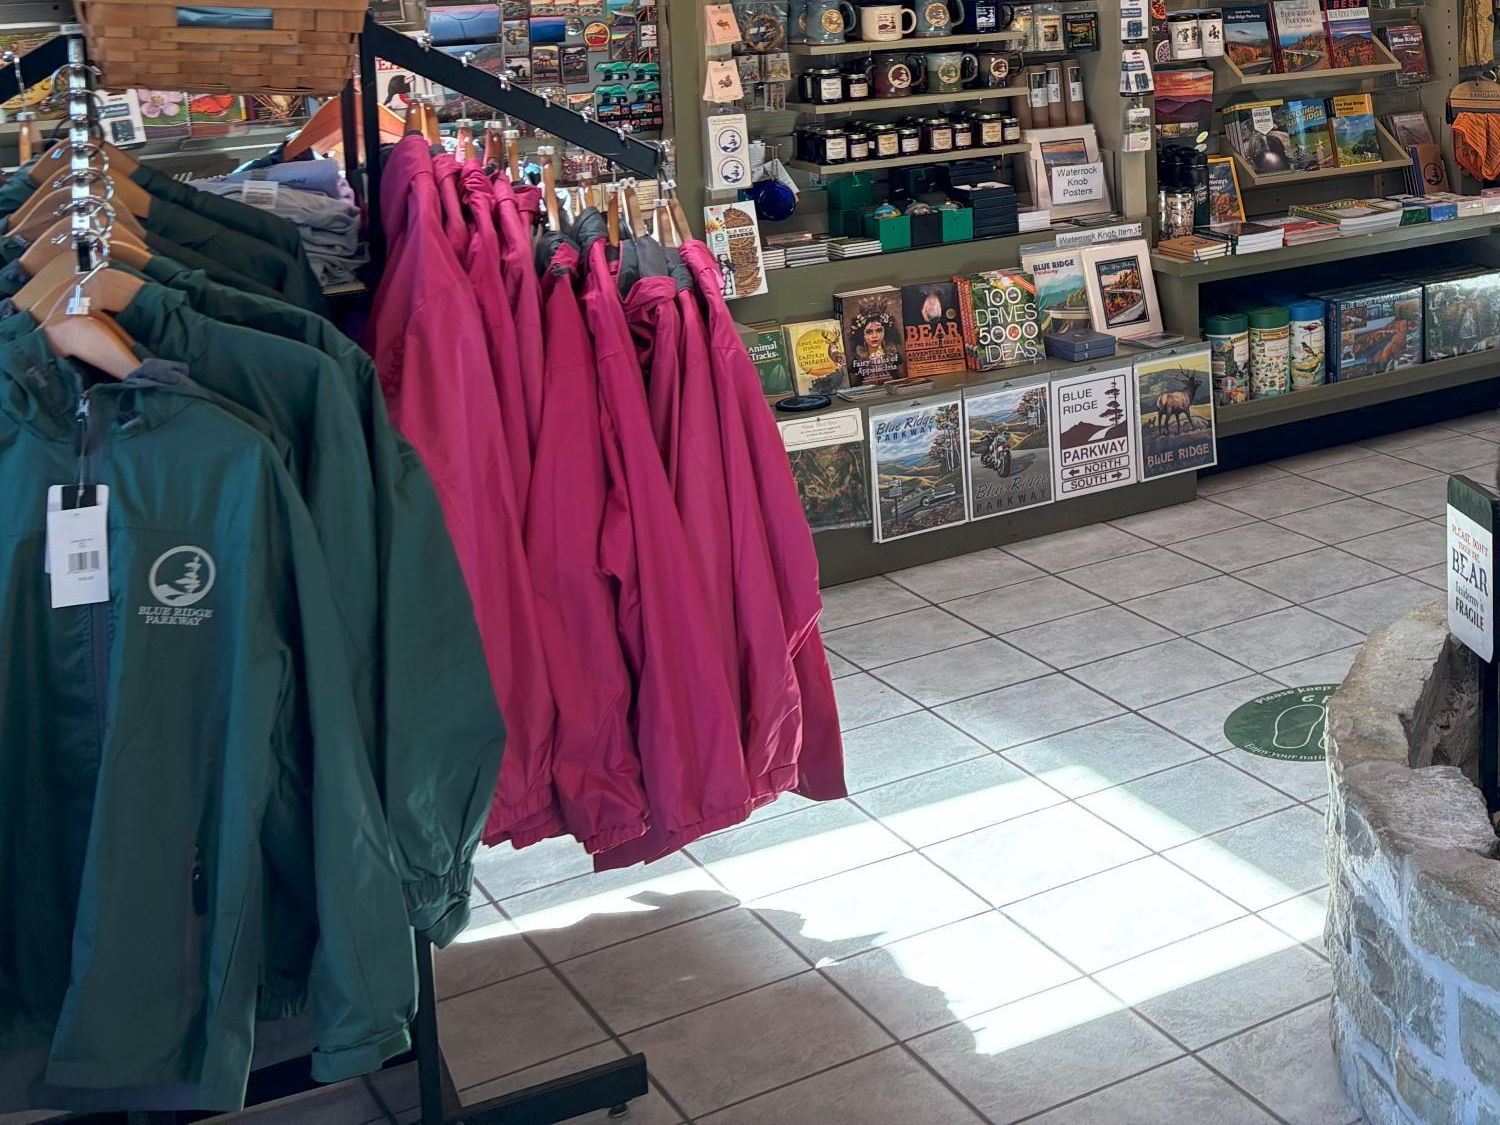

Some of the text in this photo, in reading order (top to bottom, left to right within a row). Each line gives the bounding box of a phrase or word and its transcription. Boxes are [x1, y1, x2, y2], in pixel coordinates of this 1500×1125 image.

[1333, 0, 1361, 8] BEST
[1057, 165, 1097, 178] Waterrock
[1067, 178, 1088, 187] Knob
[1063, 187, 1093, 197] Posters
[1059, 234, 1096, 245] Waterrock
[1098, 229, 1117, 241] Knob
[1033, 259, 1074, 271] BLUE RIDGE
[984, 287, 1021, 306] 100
[976, 303, 1037, 326] DRIVES
[905, 321, 960, 341] BEAR
[979, 321, 1039, 345] 5000
[748, 343, 777, 354] Animal
[751, 351, 776, 361] Tracks
[985, 341, 1037, 363] IDEAS
[853, 359, 870, 369] Fairy
[890, 354, 898, 362] of
[1063, 389, 1093, 402] BLUE
[1063, 400, 1098, 415] RIDGE
[876, 413, 936, 435] Blue Ridge
[876, 426, 934, 443] PARKWAY
[1063, 439, 1126, 463] PARKWAY
[1147, 443, 1210, 467] BLUE RIDGE
[1084, 458, 1121, 473] NORTH
[975, 475, 1048, 500] Blue Ridge
[1070, 474, 1107, 490] SOUTH
[976, 489, 1047, 513] PARKWAY
[1452, 524, 1471, 544] PLEASE
[1452, 547, 1488, 597] BEAR
[138, 606, 213, 618] BLUE RIDGE
[145, 616, 203, 625] PARKWAY
[1456, 596, 1484, 631] FRAGILE
[1254, 685, 1331, 704] Please keep
[1244, 742, 1297, 760] Enjoy your
